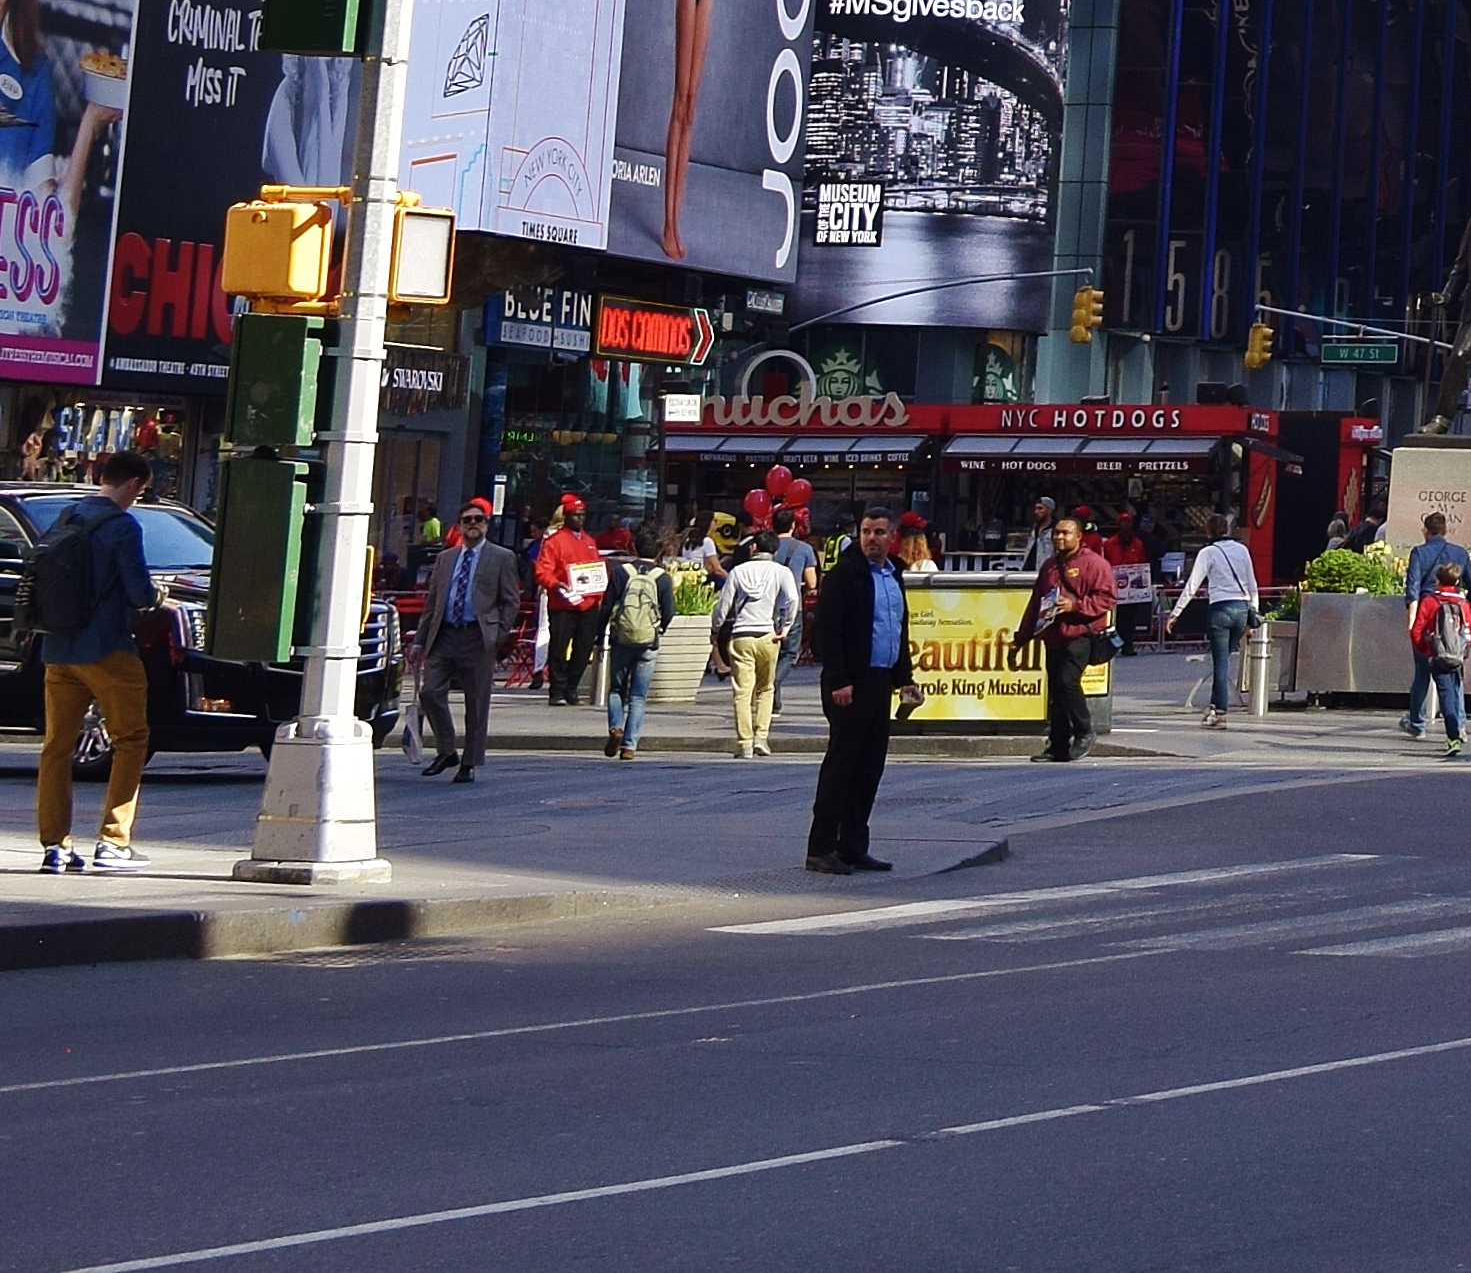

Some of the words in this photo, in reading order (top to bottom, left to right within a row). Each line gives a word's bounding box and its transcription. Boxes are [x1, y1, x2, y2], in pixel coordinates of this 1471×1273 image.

[166, 0, 247, 52] CRIMINAL
[185, 66, 222, 108] MISS
[219, 65, 248, 108] IT
[818, 183, 882, 205] MUSEUM
[828, 203, 880, 232] CITY
[521, 220, 545, 240] TIMES
[546, 224, 579, 245] SQUARE
[816, 229, 830, 244] OF
[831, 230, 850, 244] NEW
[851, 230, 878, 244] YORK
[560, 290, 594, 327] FIN
[502, 322, 550, 344] SEAFOOD
[1338, 348, 1350, 359] W
[1353, 347, 1365, 359] 47
[392, 367, 443, 392] SWAROVSKI
[1001, 409, 1039, 429] NYC
[960, 460, 986, 471] WINE
[1001, 460, 1024, 471] HOT
[1026, 460, 1058, 472] DOGS
[1138, 460, 1190, 472] PRETZELS
[1418, 490, 1467, 504] GEORGE
[951, 677, 986, 700] King
[988, 677, 1042, 697] Musical
